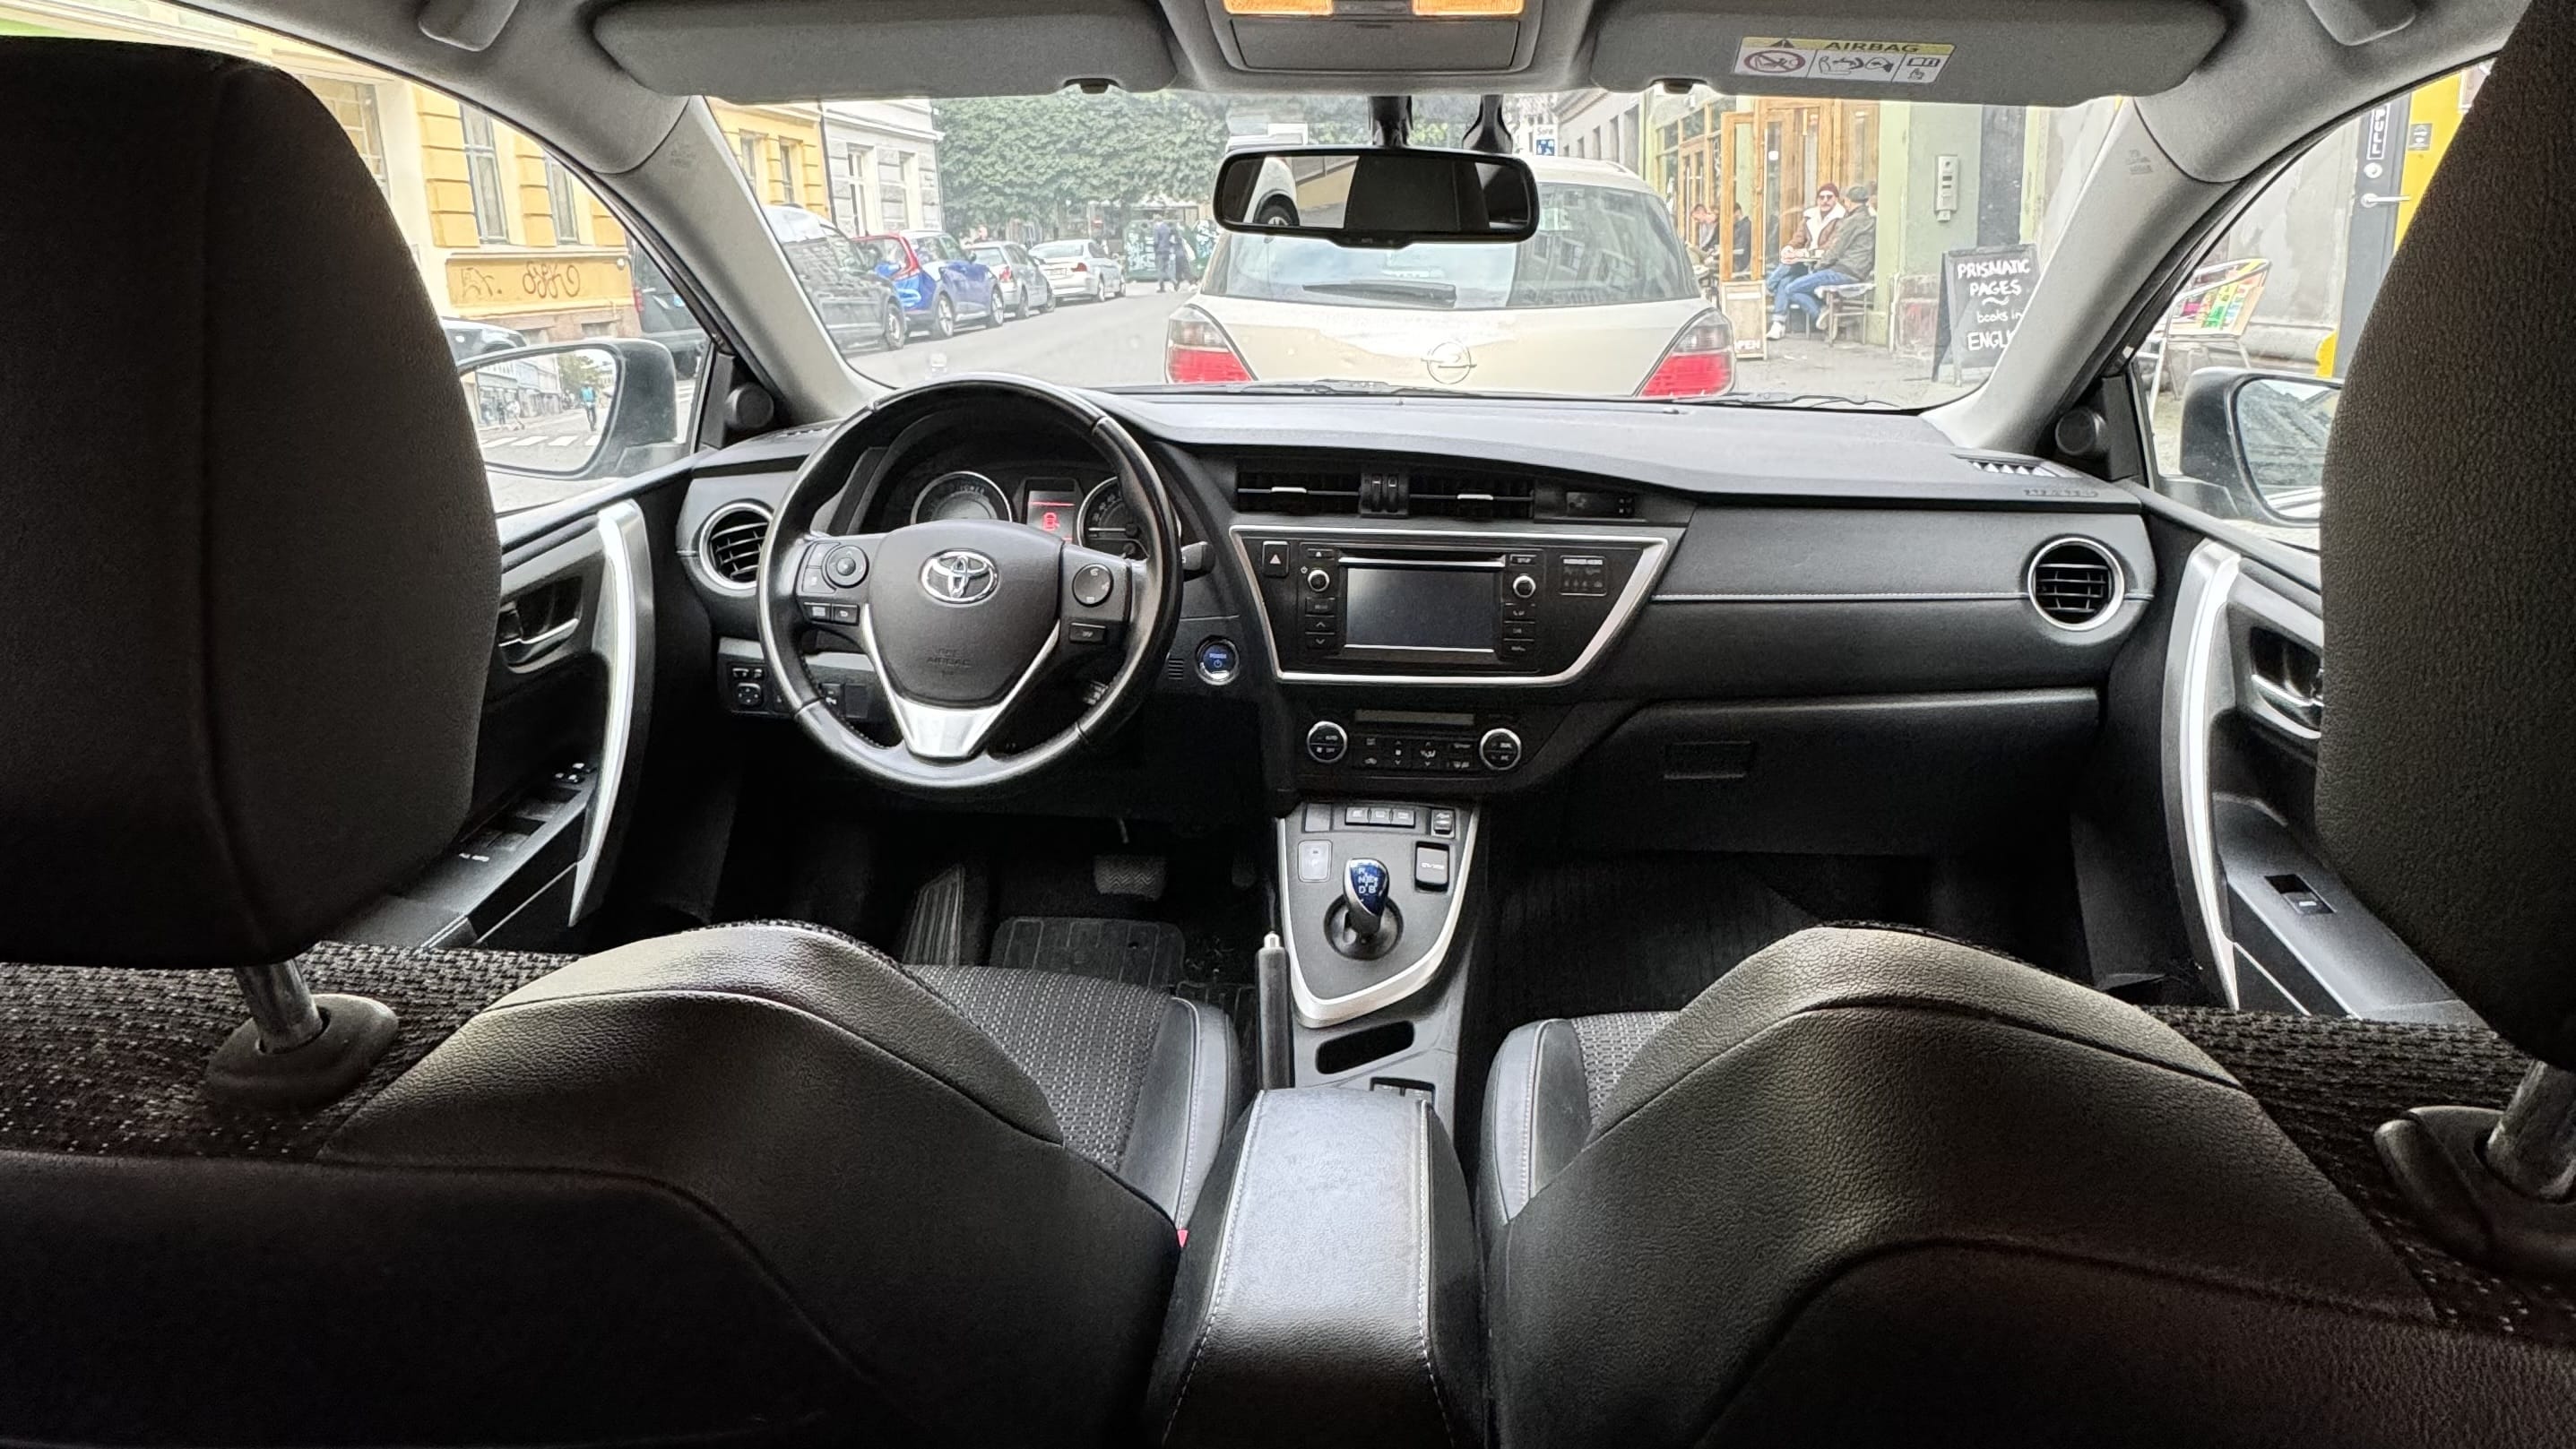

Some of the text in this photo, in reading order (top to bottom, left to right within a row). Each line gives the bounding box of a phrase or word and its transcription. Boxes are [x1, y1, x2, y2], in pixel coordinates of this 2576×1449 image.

[1825, 41, 1919, 52] AIRBAG
[1957, 259, 2030, 280] PRISMATIC
[1969, 280, 2022, 297] PAGES
[1976, 309, 2009, 323] books
[1967, 330, 2014, 351] ENGLI
